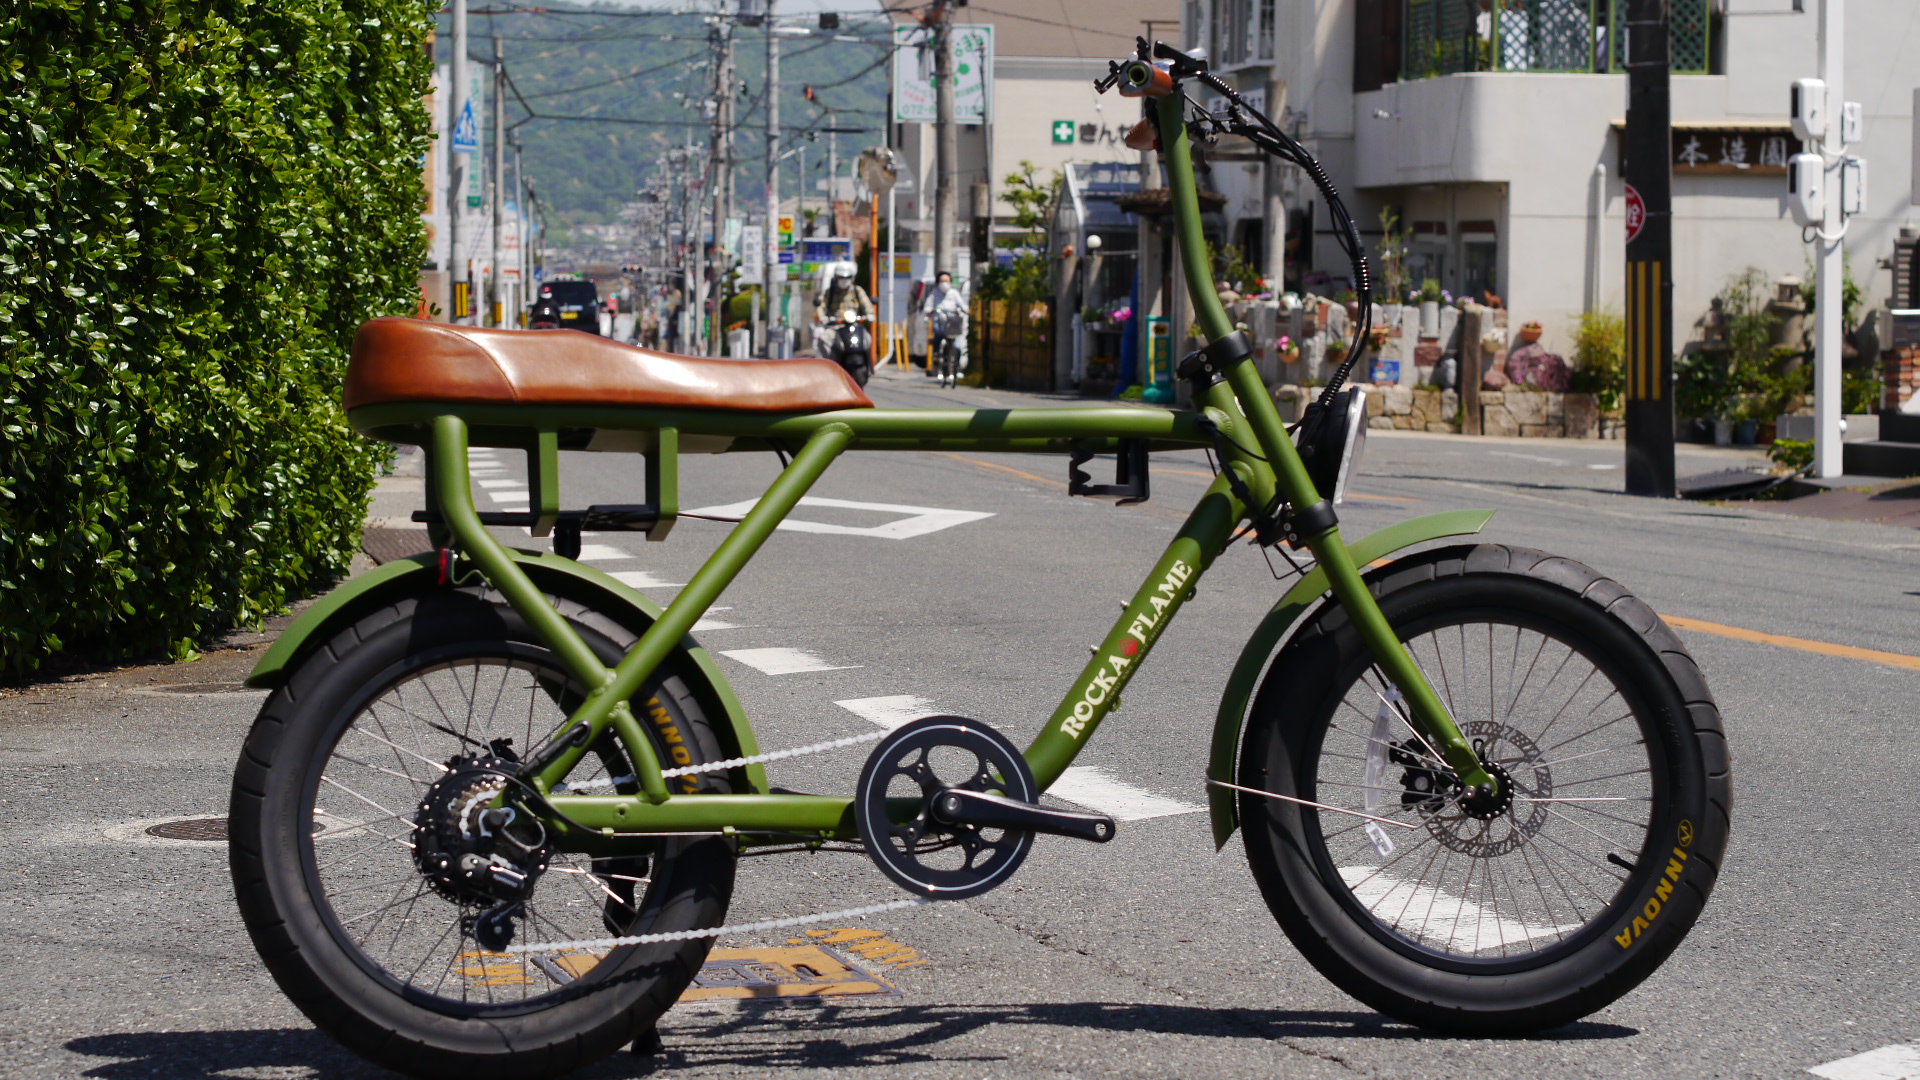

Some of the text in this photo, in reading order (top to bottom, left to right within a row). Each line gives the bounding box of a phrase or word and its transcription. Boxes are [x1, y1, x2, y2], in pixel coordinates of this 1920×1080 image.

[1060, 655, 1131, 740] ROCKA
[1127, 559, 1193, 645] FLAME
[1614, 847, 1688, 949] INNOVA
